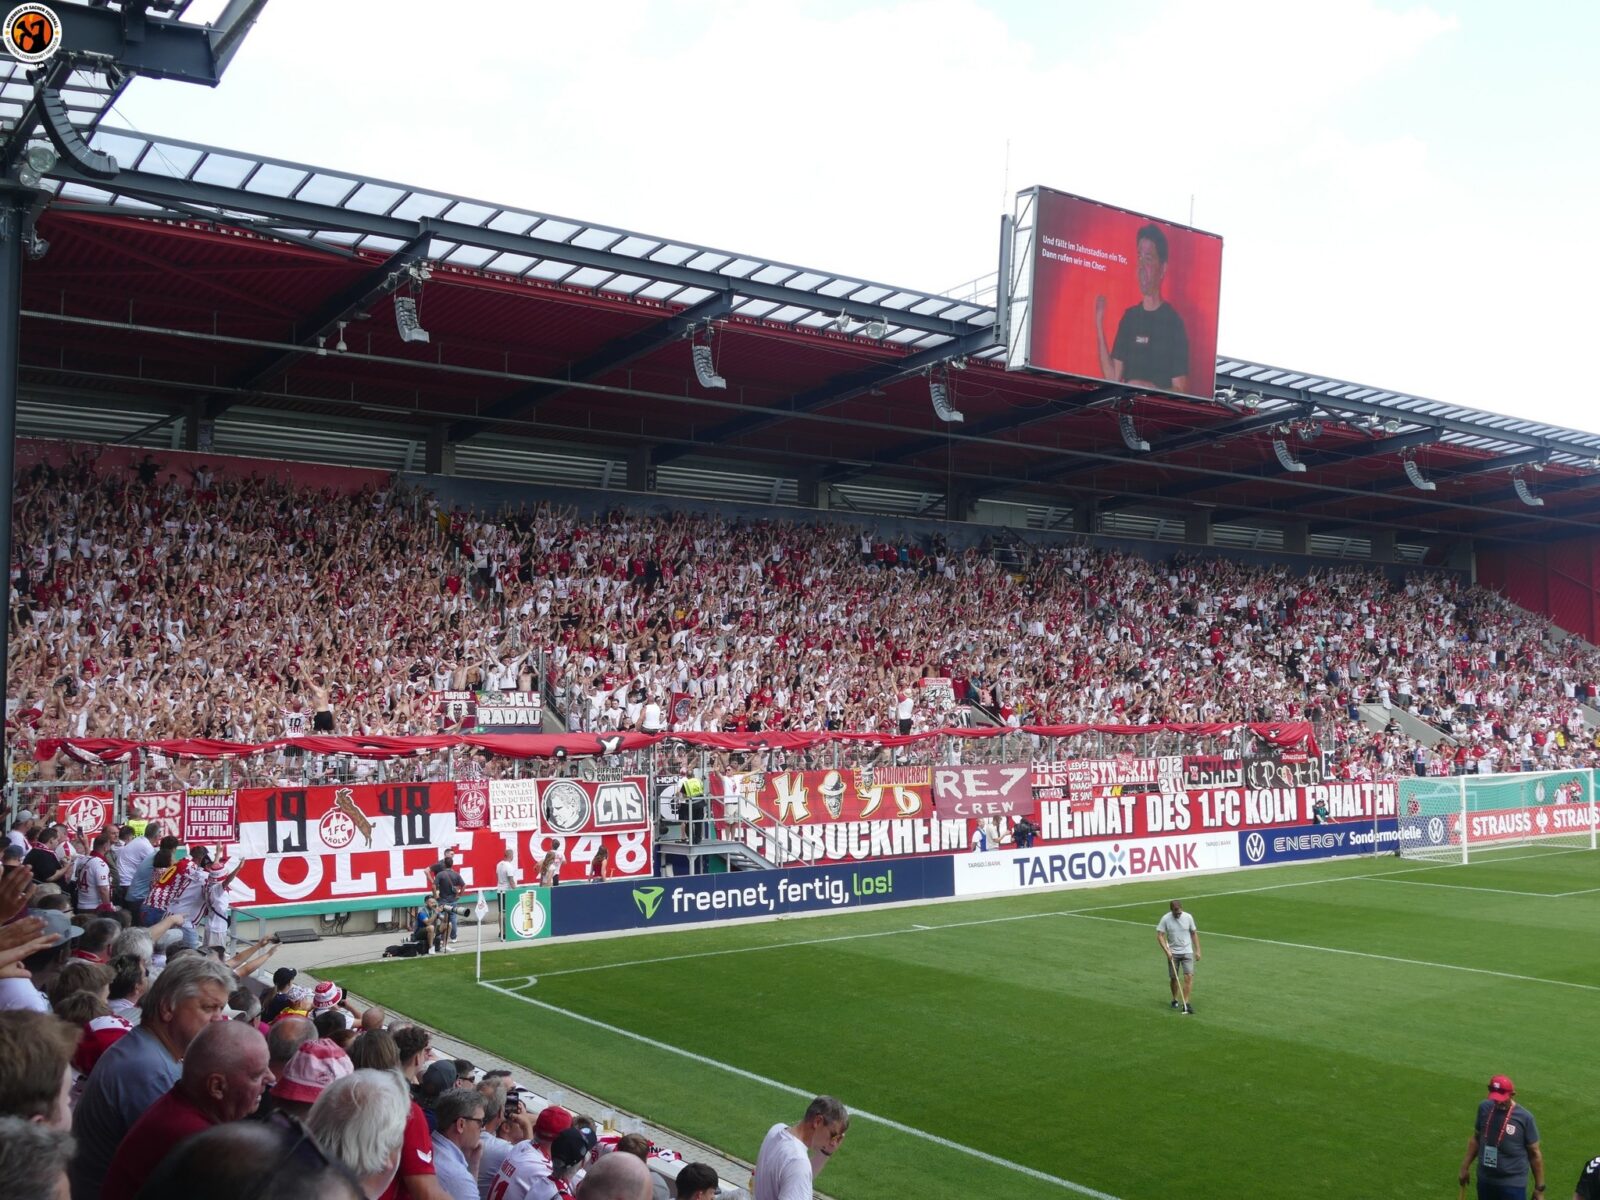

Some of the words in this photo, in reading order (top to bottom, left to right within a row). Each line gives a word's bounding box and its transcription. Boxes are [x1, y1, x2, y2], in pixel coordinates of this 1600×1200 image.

[1042, 235, 1055, 246] Und
[1075, 243, 1109, 260] Jahnstadion
[1042, 248, 1057, 260] Dann
[1057, 252, 1073, 264] rufen
[444, 691, 471, 700] RAFIKIS
[479, 709, 541, 725] RADAU
[873, 767, 929, 785] STADIONVERBOT
[935, 768, 1027, 798] RE7
[133, 795, 181, 818] SPS
[492, 804, 534, 819] FREI
[954, 801, 1014, 815] CREW
[1040, 796, 1136, 840] HEIMAT
[1146, 791, 1191, 832] DES
[1198, 788, 1241, 828] 1.FC
[1472, 812, 1532, 837] STRAUSS
[1273, 833, 1346, 853] ENERGY
[1350, 826, 1421, 846] Sondermodelle
[671, 882, 774, 914] freenet,
[777, 874, 850, 905] fertig,
[853, 869, 893, 896] los!
